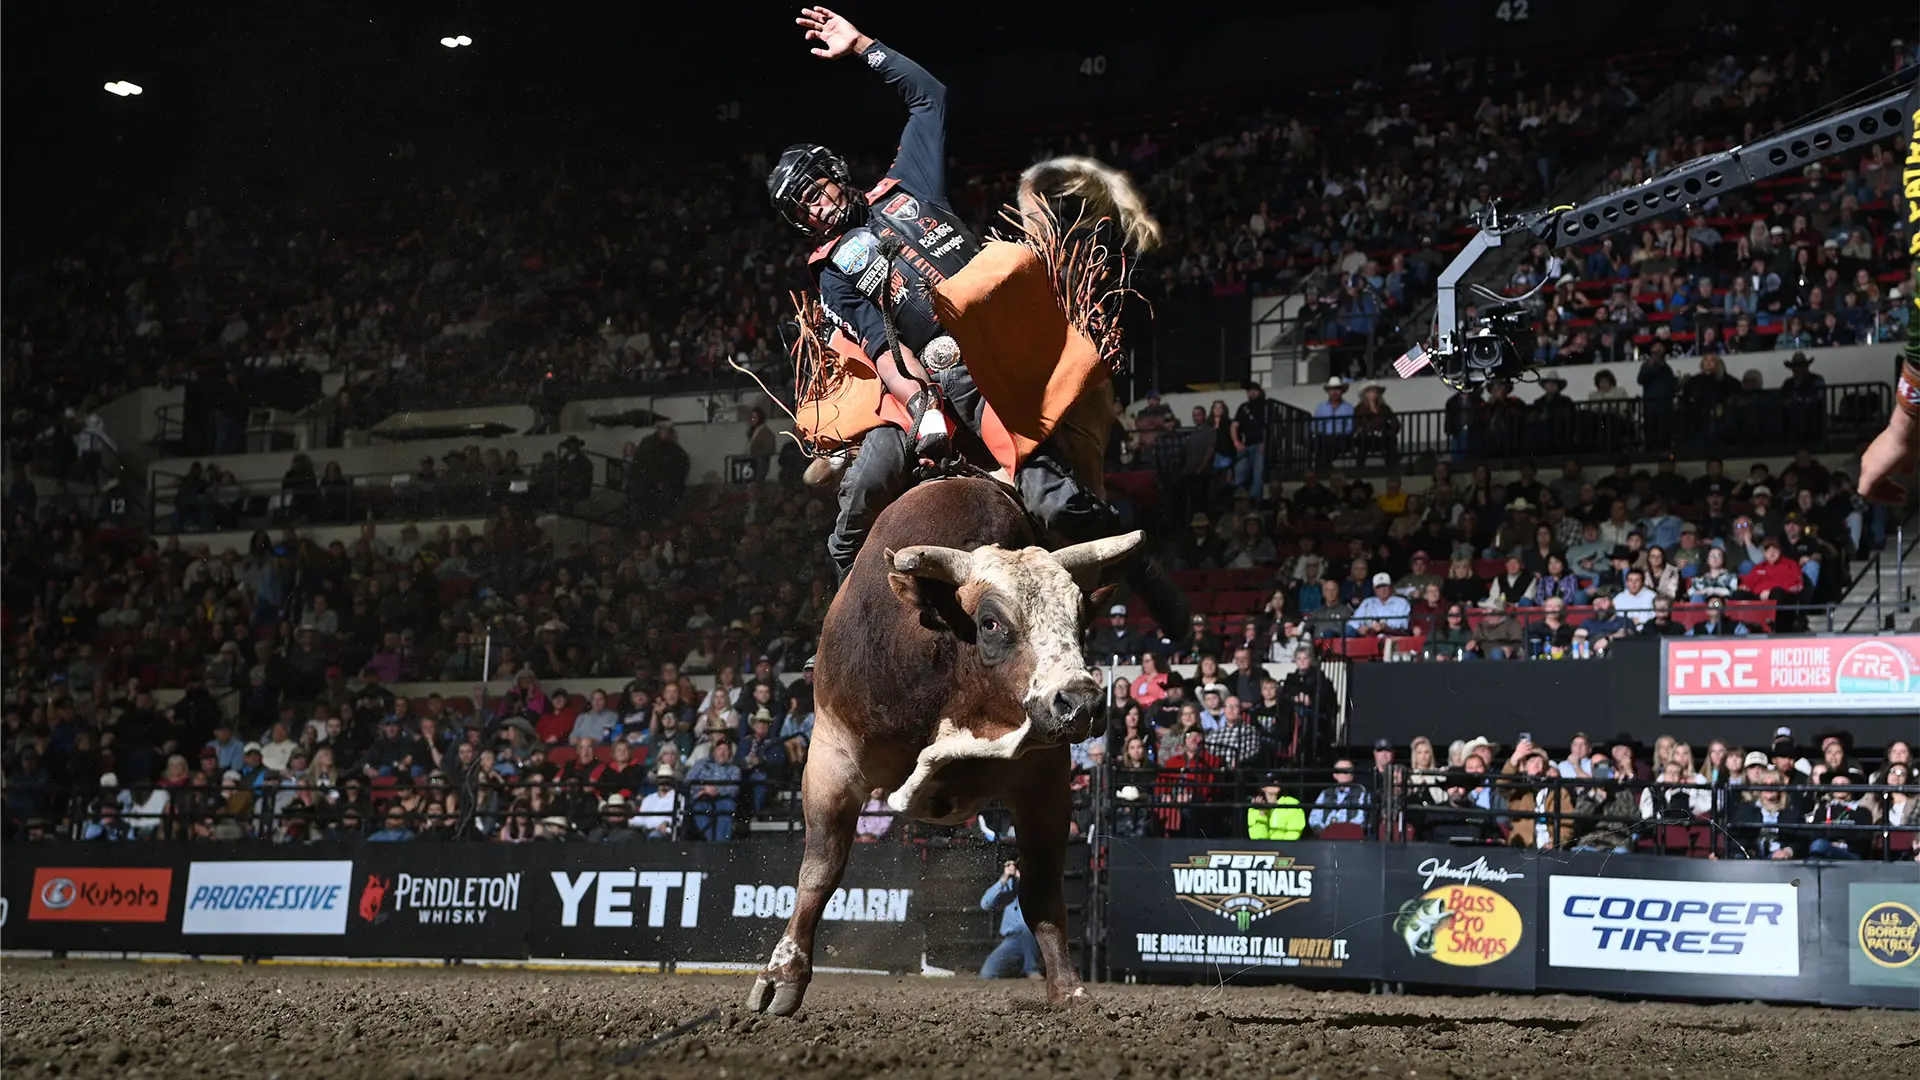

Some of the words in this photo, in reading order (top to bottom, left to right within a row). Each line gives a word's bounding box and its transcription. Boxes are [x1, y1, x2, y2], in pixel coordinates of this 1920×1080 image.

[1496, 0, 1529, 21] 42
[1080, 56, 1106, 75] 40
[930, 234, 965, 258] Wrangler
[735, 462, 753, 480] 16
[111, 498, 126, 515] 12
[1675, 648, 1758, 688] FRE
[1770, 647, 1830, 667] NICOTINE
[1852, 653, 1896, 677] FRE
[1770, 667, 1831, 687] POUCHES
[1209, 854, 1277, 869] PBR
[81, 882, 159, 906] Kubota
[394, 873, 521, 911] PENDLETON
[1173, 868, 1242, 894] WORLD
[1245, 870, 1313, 897] FINALS
[189, 884, 343, 911] PROGRESSIVE
[550, 871, 701, 927] YETI
[732, 884, 797, 919] BOO
[822, 887, 909, 922] BARN
[1447, 888, 1495, 913] Bass
[418, 909, 487, 924] WHISKY
[1448, 909, 1484, 932] Pro
[1563, 895, 1784, 926] COOPER
[1591, 927, 1748, 955] TIRES
[1867, 925, 1917, 938] BORDER
[1136, 933, 1159, 953] THE
[1160, 934, 1205, 955] BUCKLE
[1206, 935, 1248, 957] MAKES
[1249, 937, 1264, 957] IT
[1263, 937, 1286, 958] ALL
[1287, 937, 1332, 959] WORTH
[1333, 939, 1350, 960] IT.
[1447, 930, 1507, 960] Shops
[1867, 938, 1914, 951] PATROL
